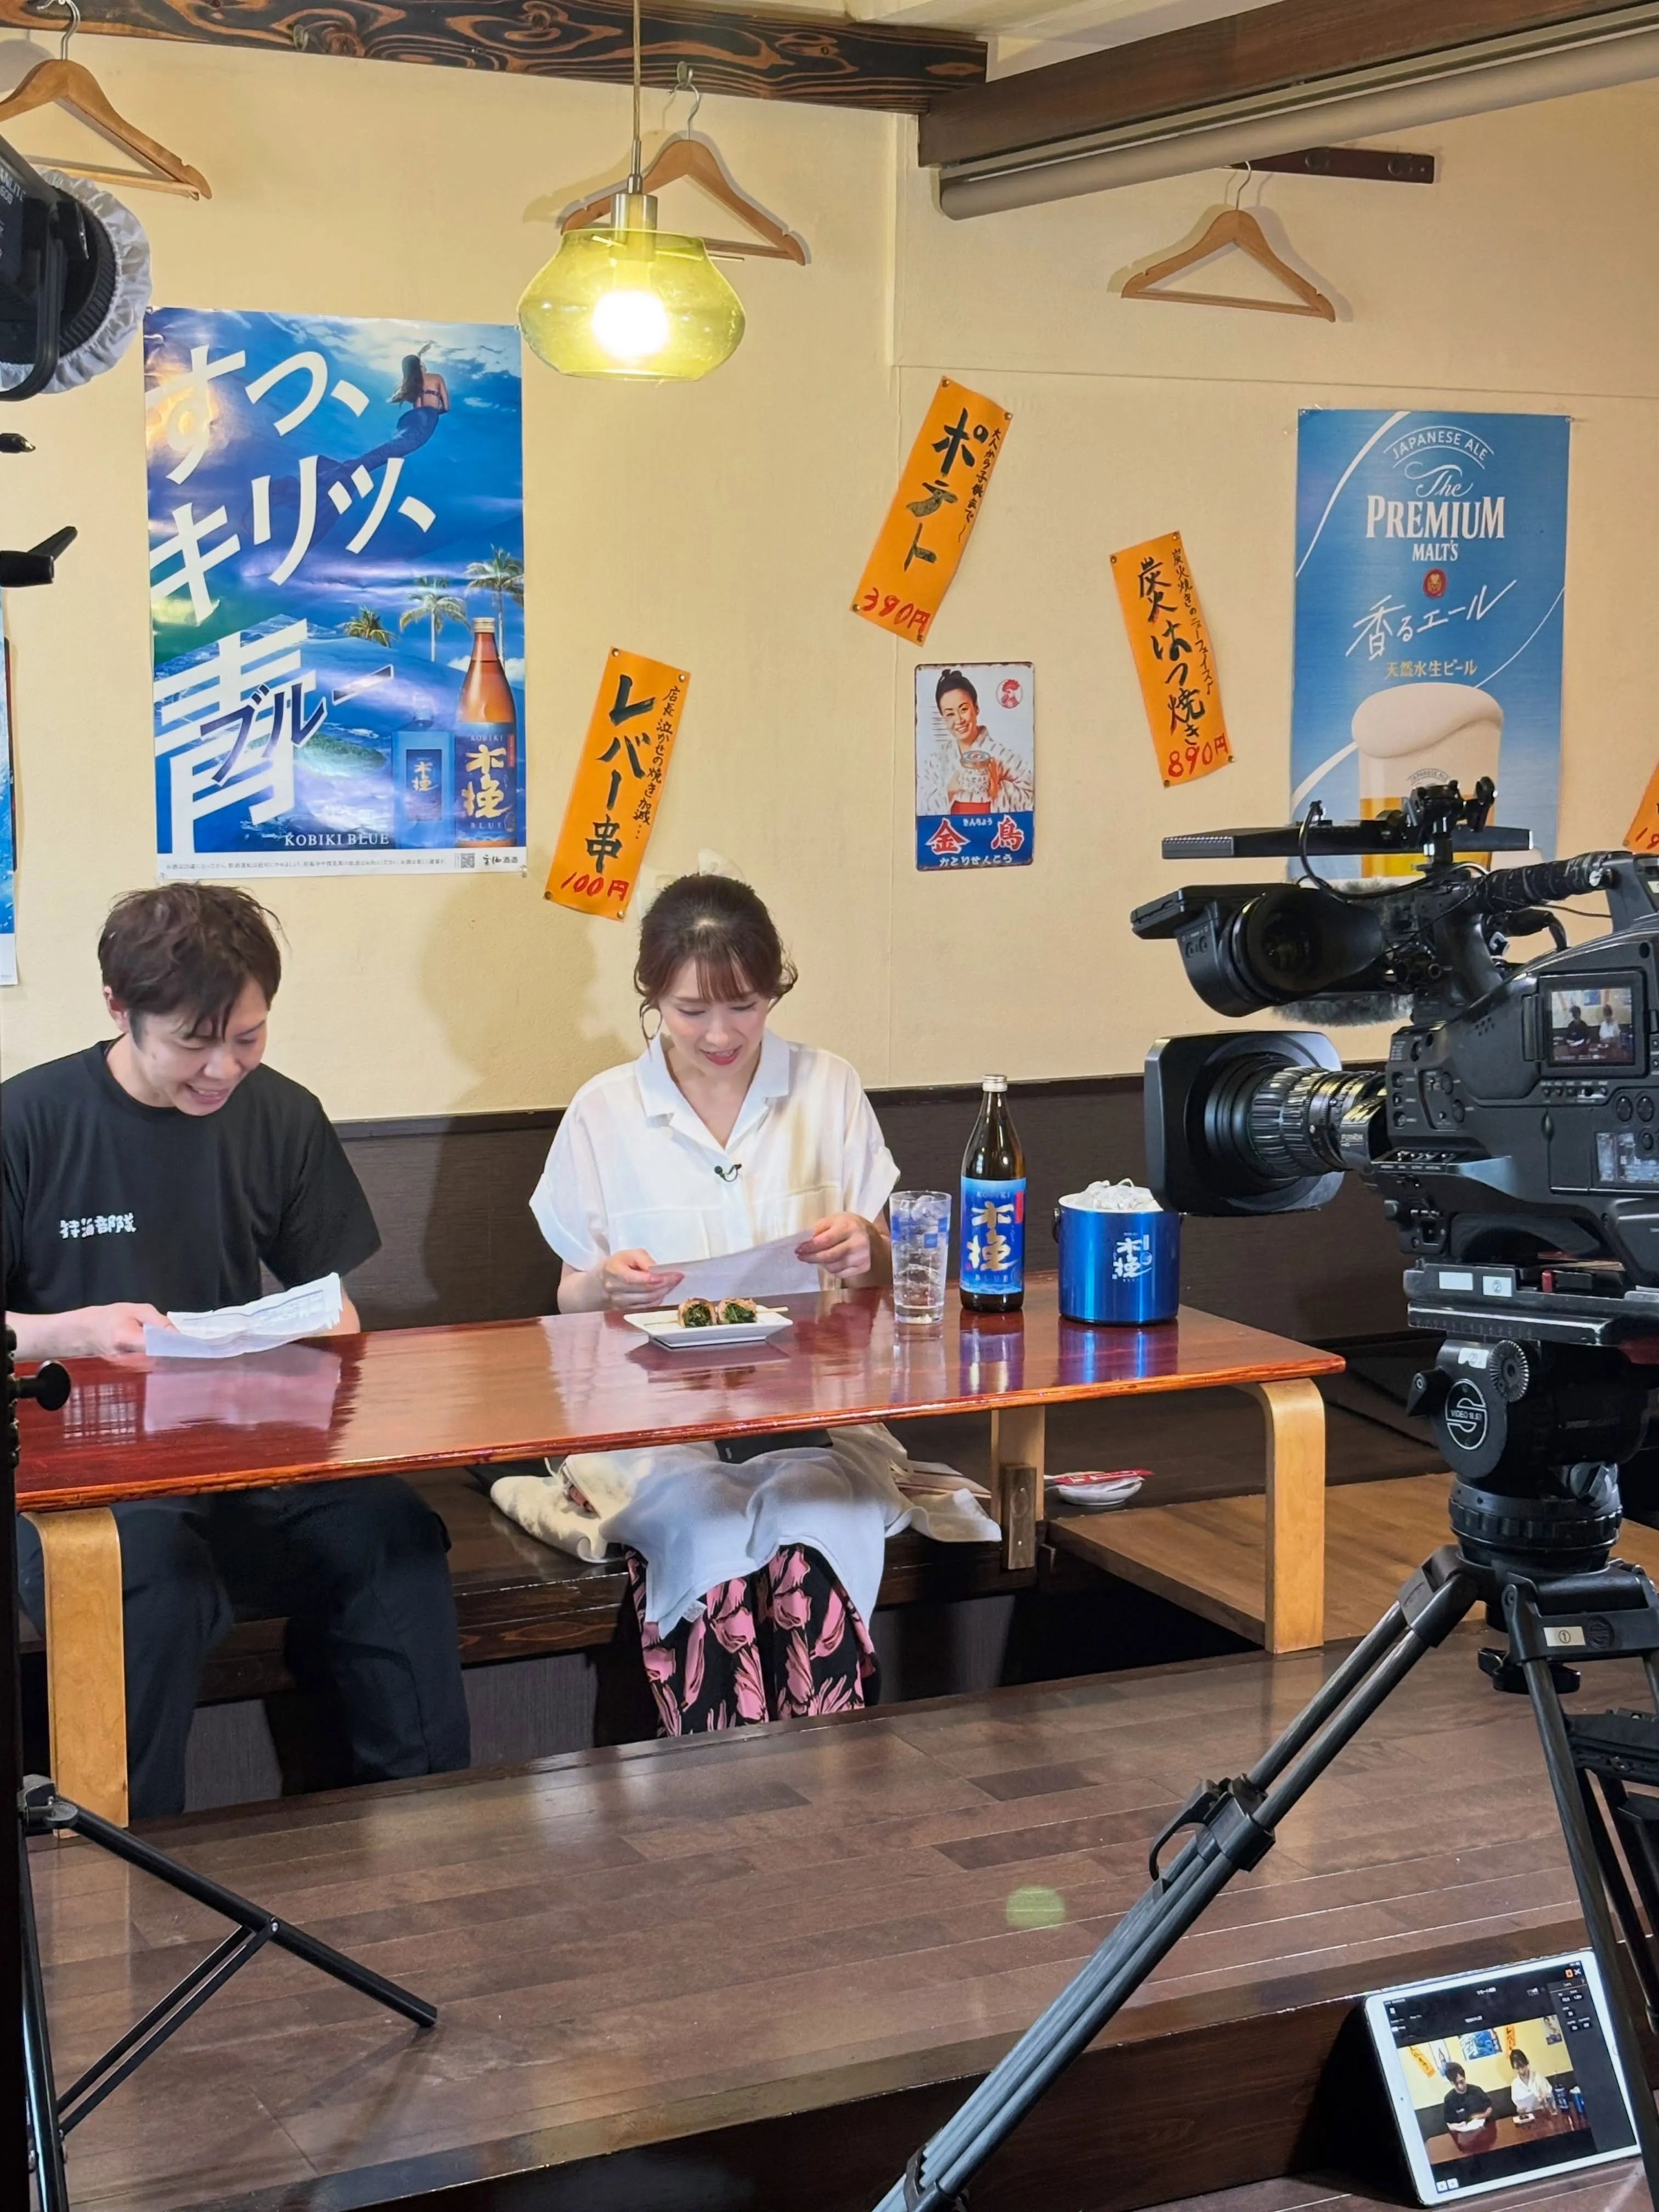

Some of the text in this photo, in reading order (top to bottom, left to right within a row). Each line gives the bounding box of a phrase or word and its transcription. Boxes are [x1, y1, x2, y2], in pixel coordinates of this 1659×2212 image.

[1392, 431, 1488, 461] JAPANESE ALE
[905, 407, 989, 573] ポテト
[1404, 464, 1474, 498] The
[1365, 495, 1505, 539] PREMIUM
[1412, 540, 1459, 562] MALT'S
[861, 588, 931, 634] 390円
[1345, 580, 1517, 661] 香るエール
[1385, 659, 1477, 679] 天然水生ビール
[153, 618, 316, 854] 青
[200, 664, 394, 786] ブルー
[584, 674, 656, 873] レバー串
[1168, 733, 1228, 777] 890円
[284, 833, 390, 847] KOBIKI BLUE
[963, 818, 992, 827] きんちょう
[939, 854, 1013, 867] かとりせんこう
[561, 871, 629, 901] 100円
